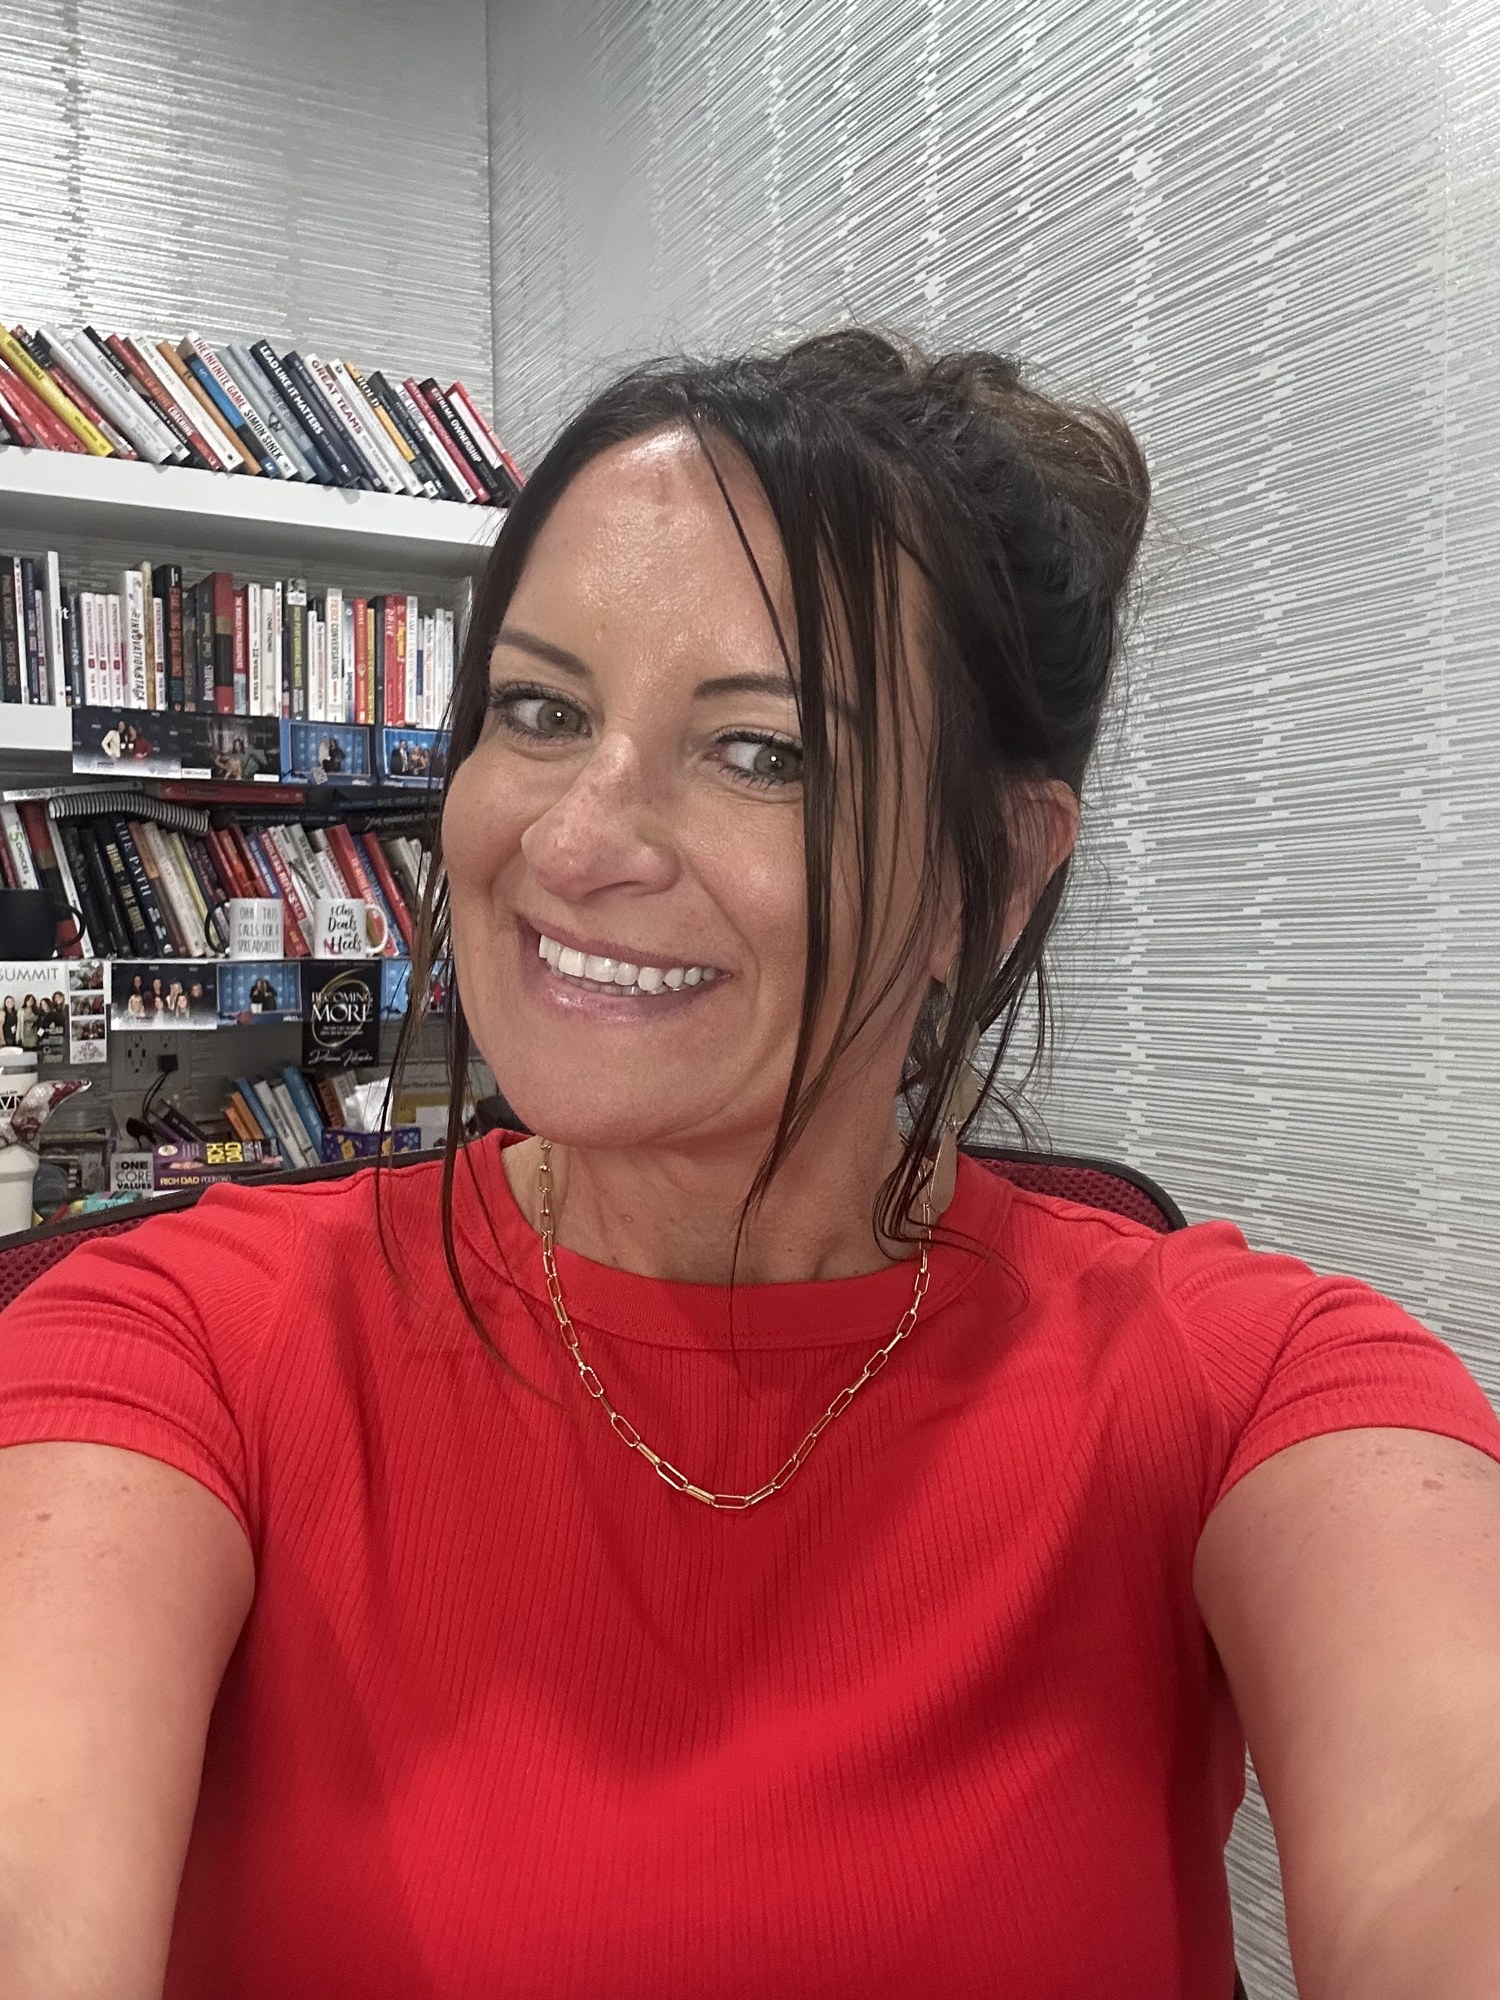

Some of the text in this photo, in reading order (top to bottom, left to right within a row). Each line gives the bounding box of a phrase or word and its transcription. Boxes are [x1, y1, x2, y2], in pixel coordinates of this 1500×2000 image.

[192, 336, 209, 355] THE
[202, 350, 232, 387] INFINITE
[225, 384, 247, 409] GAME
[242, 408, 267, 438] SIMON
[261, 434, 283, 460] SINEK
[258, 343, 324, 434] LEAD LIKE IT MATTERS
[310, 358, 338, 396] GREAT
[335, 396, 364, 434] TEAMS
[167, 404, 194, 437] COACHING
[429, 386, 455, 420] EXTREME
[448, 417, 483, 464] OWNERSHIP
[385, 608, 393, 636] DRIVE
[4, 640, 15, 663] SHOE
[330, 622, 339, 679] CONVERSATIONS
[6, 666, 16, 685] DOG
[7, 829, 22, 844] 5
[13, 840, 31, 874] CHOICES
[115, 819, 152, 897] THE PATH
[260, 831, 284, 873] ENDLESS
[328, 915, 357, 932] Deals
[331, 933, 361, 952] Heels
[312, 992, 373, 1002] BECOMING
[312, 1003, 373, 1022] MORE
[116, 1171, 152, 1181] CORE
[121, 1161, 148, 1169] ONE
[160, 1177, 180, 1185] RICH
[181, 1176, 200, 1185] DAD
